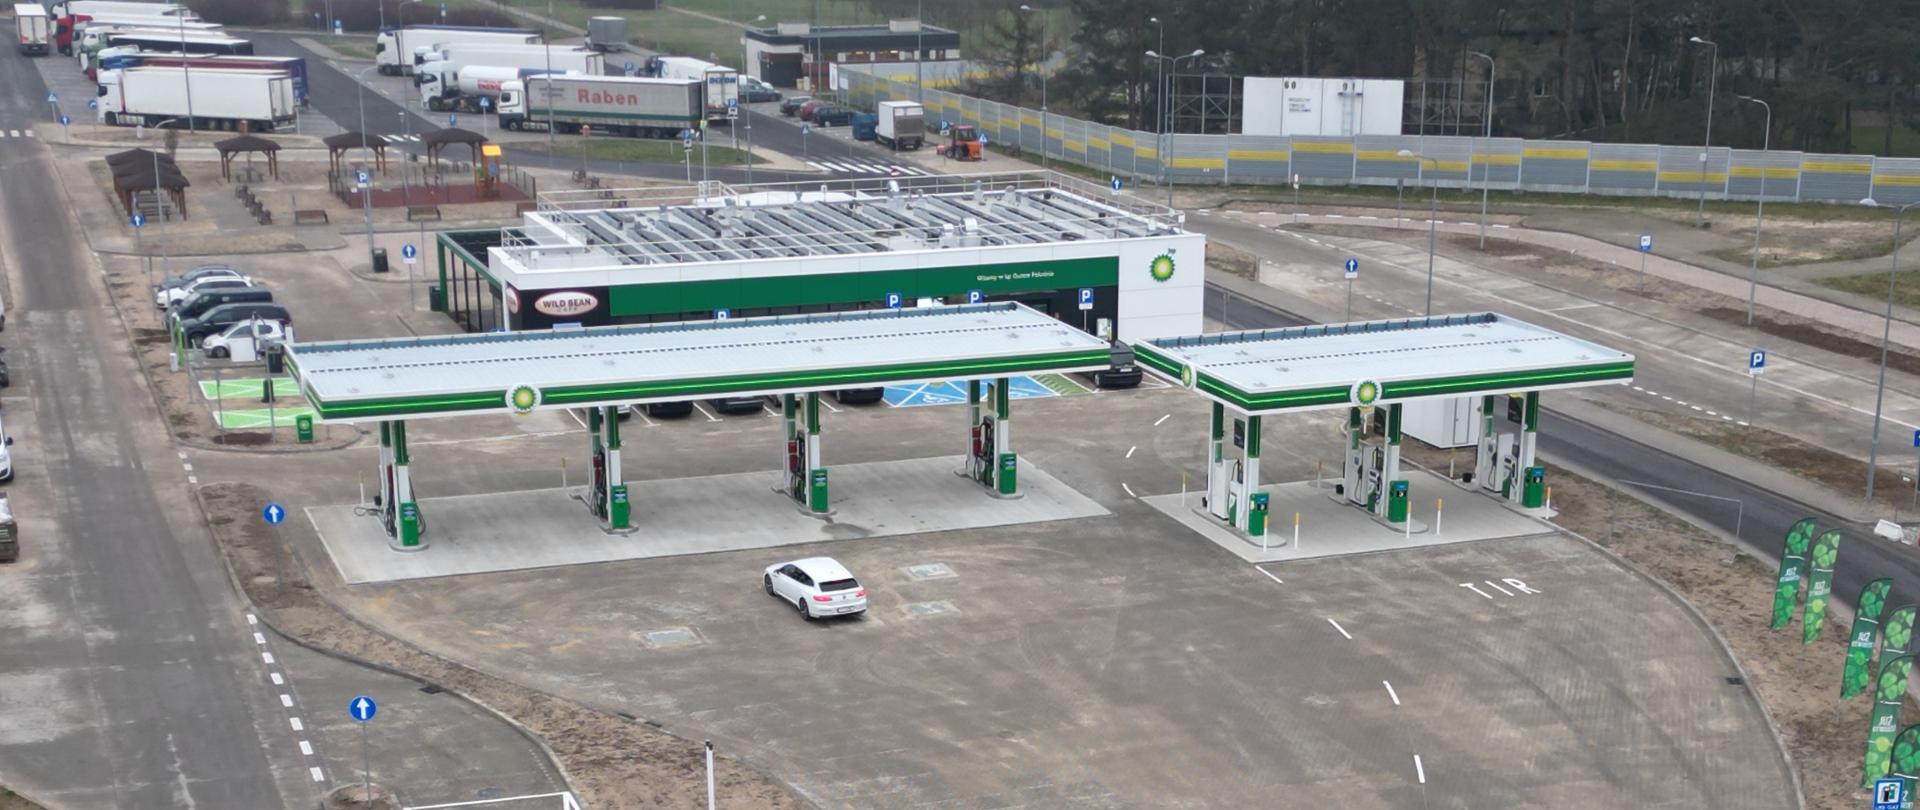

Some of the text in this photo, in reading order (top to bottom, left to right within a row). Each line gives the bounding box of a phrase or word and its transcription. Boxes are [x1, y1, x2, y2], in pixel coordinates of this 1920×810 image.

[577, 88, 638, 105] Raben
[542, 298, 591, 309] WILD BEAN
[889, 294, 899, 308] P
[971, 291, 980, 304] P
[1082, 290, 1091, 303] P
[1753, 353, 1763, 367] P
[1458, 578, 1542, 599] TIR
